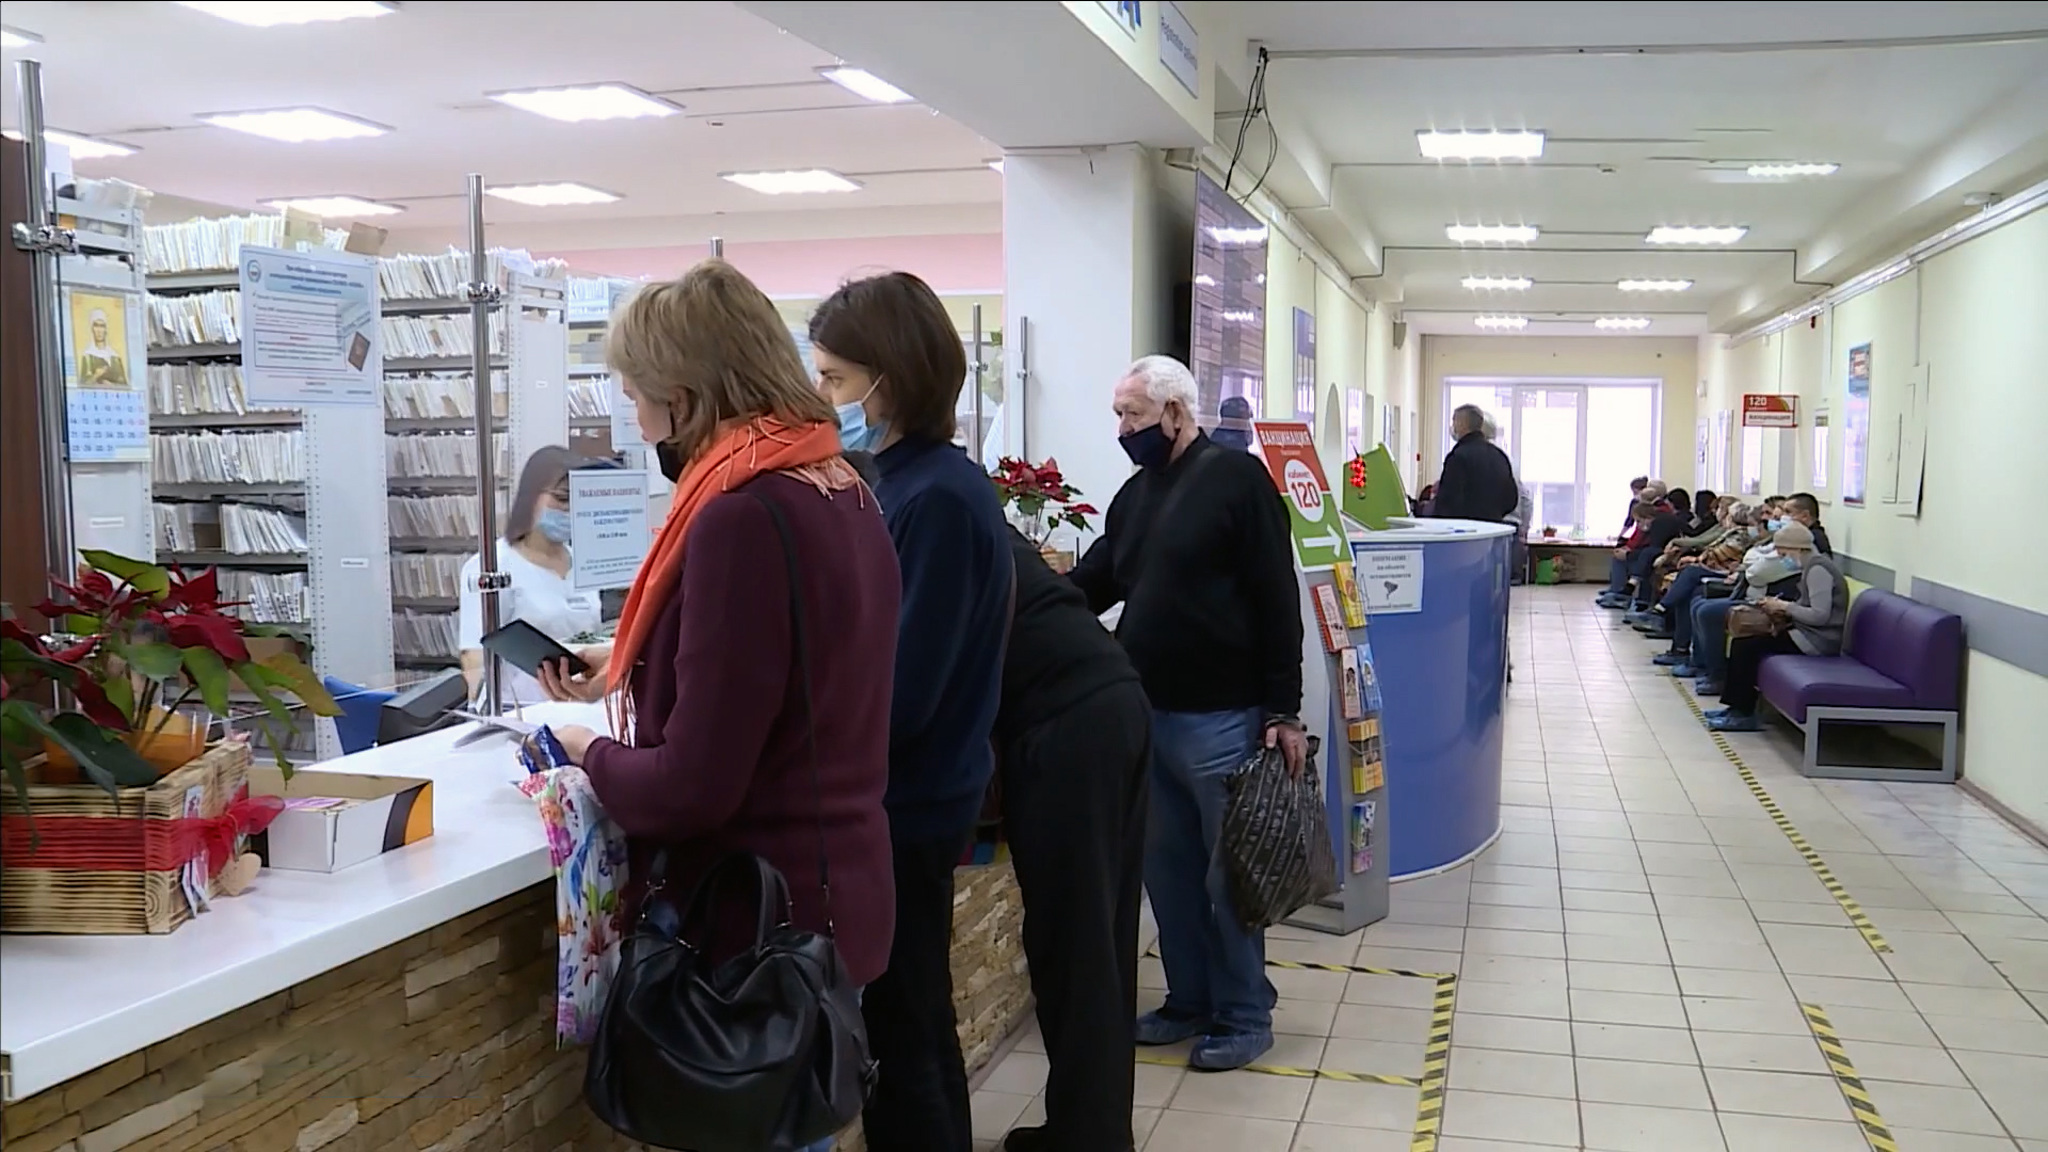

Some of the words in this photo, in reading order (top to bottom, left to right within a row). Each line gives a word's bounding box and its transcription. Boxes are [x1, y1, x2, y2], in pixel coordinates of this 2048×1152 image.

[1749, 397, 1767, 406] 120
[1259, 430, 1313, 448] ВАКЦИНАЦИЯ
[1291, 482, 1321, 508] 120
